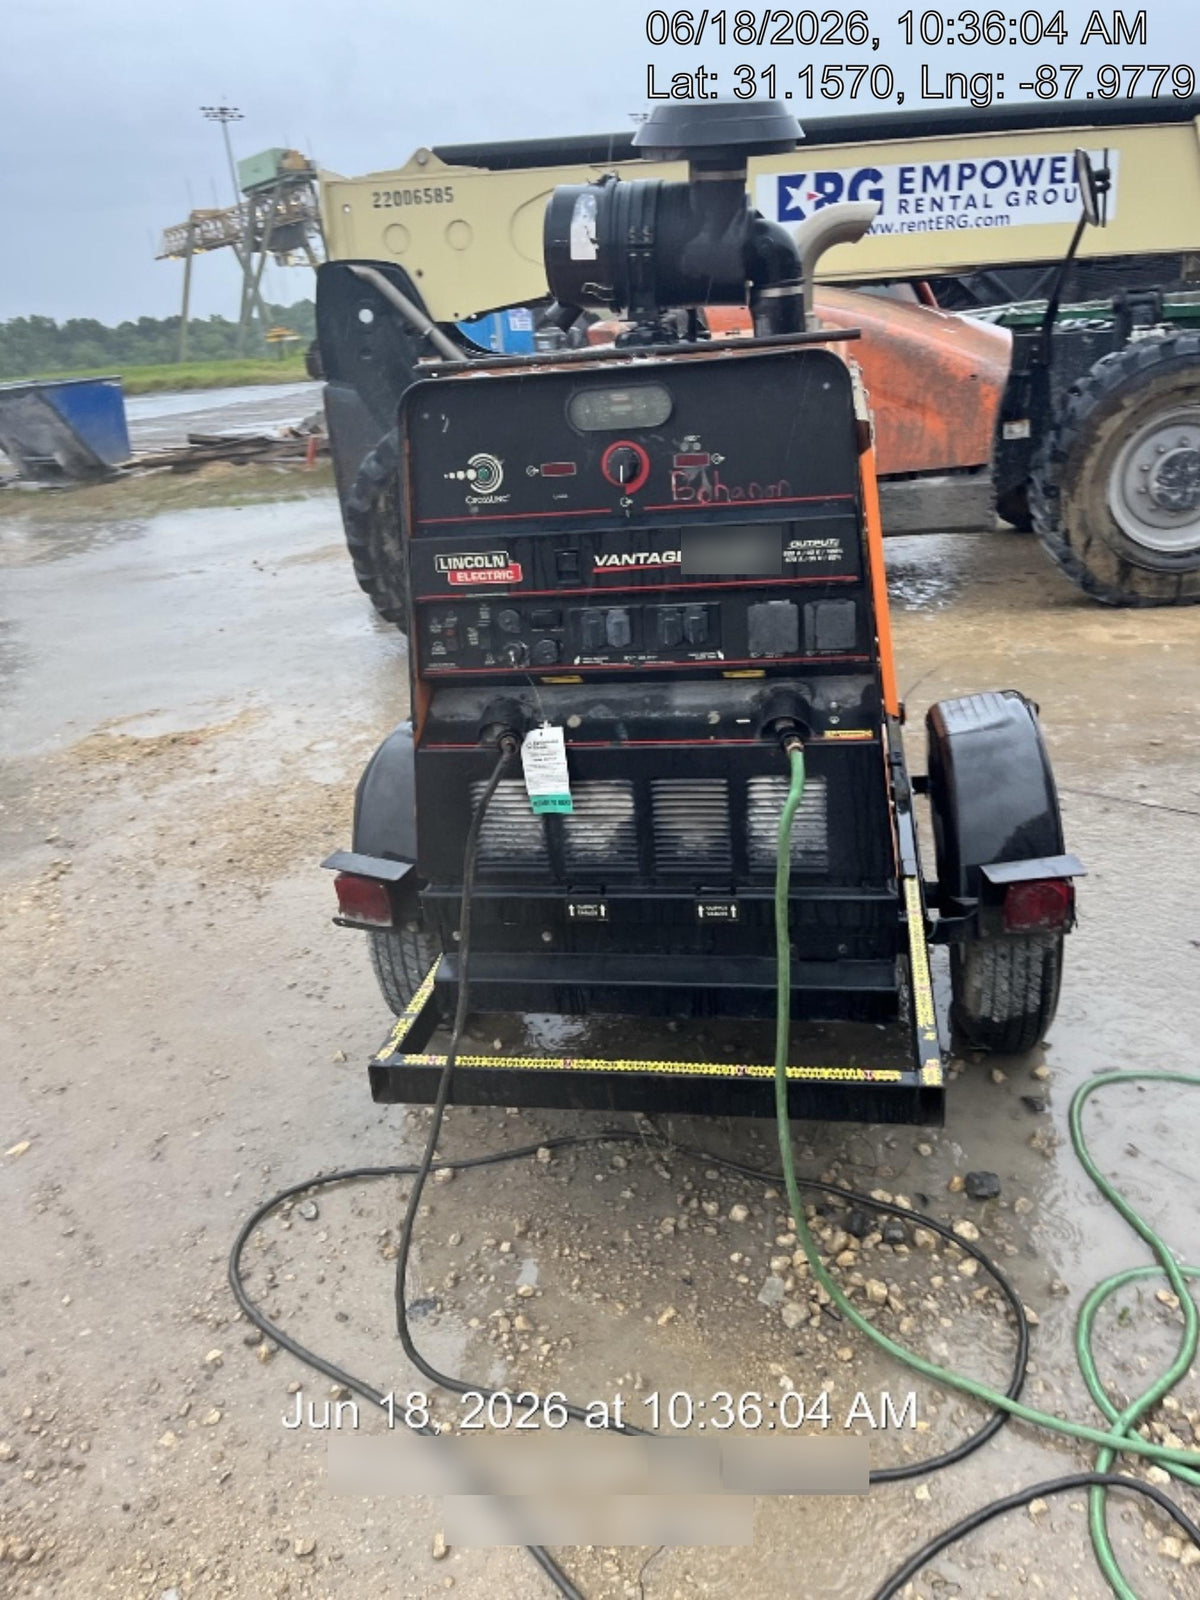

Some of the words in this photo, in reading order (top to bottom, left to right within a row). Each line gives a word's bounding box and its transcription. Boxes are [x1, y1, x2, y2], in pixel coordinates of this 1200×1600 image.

[899, 154, 1080, 195] EMPOWE
[372, 186, 454, 209] 22006585
[899, 193, 993, 215] RENTAL
[1005, 187, 1078, 208] GROU
[868, 213, 1010, 236] w.rentERG.com
[439, 554, 505, 570] LINCOLN
[456, 570, 515, 582] ELECTRIC
